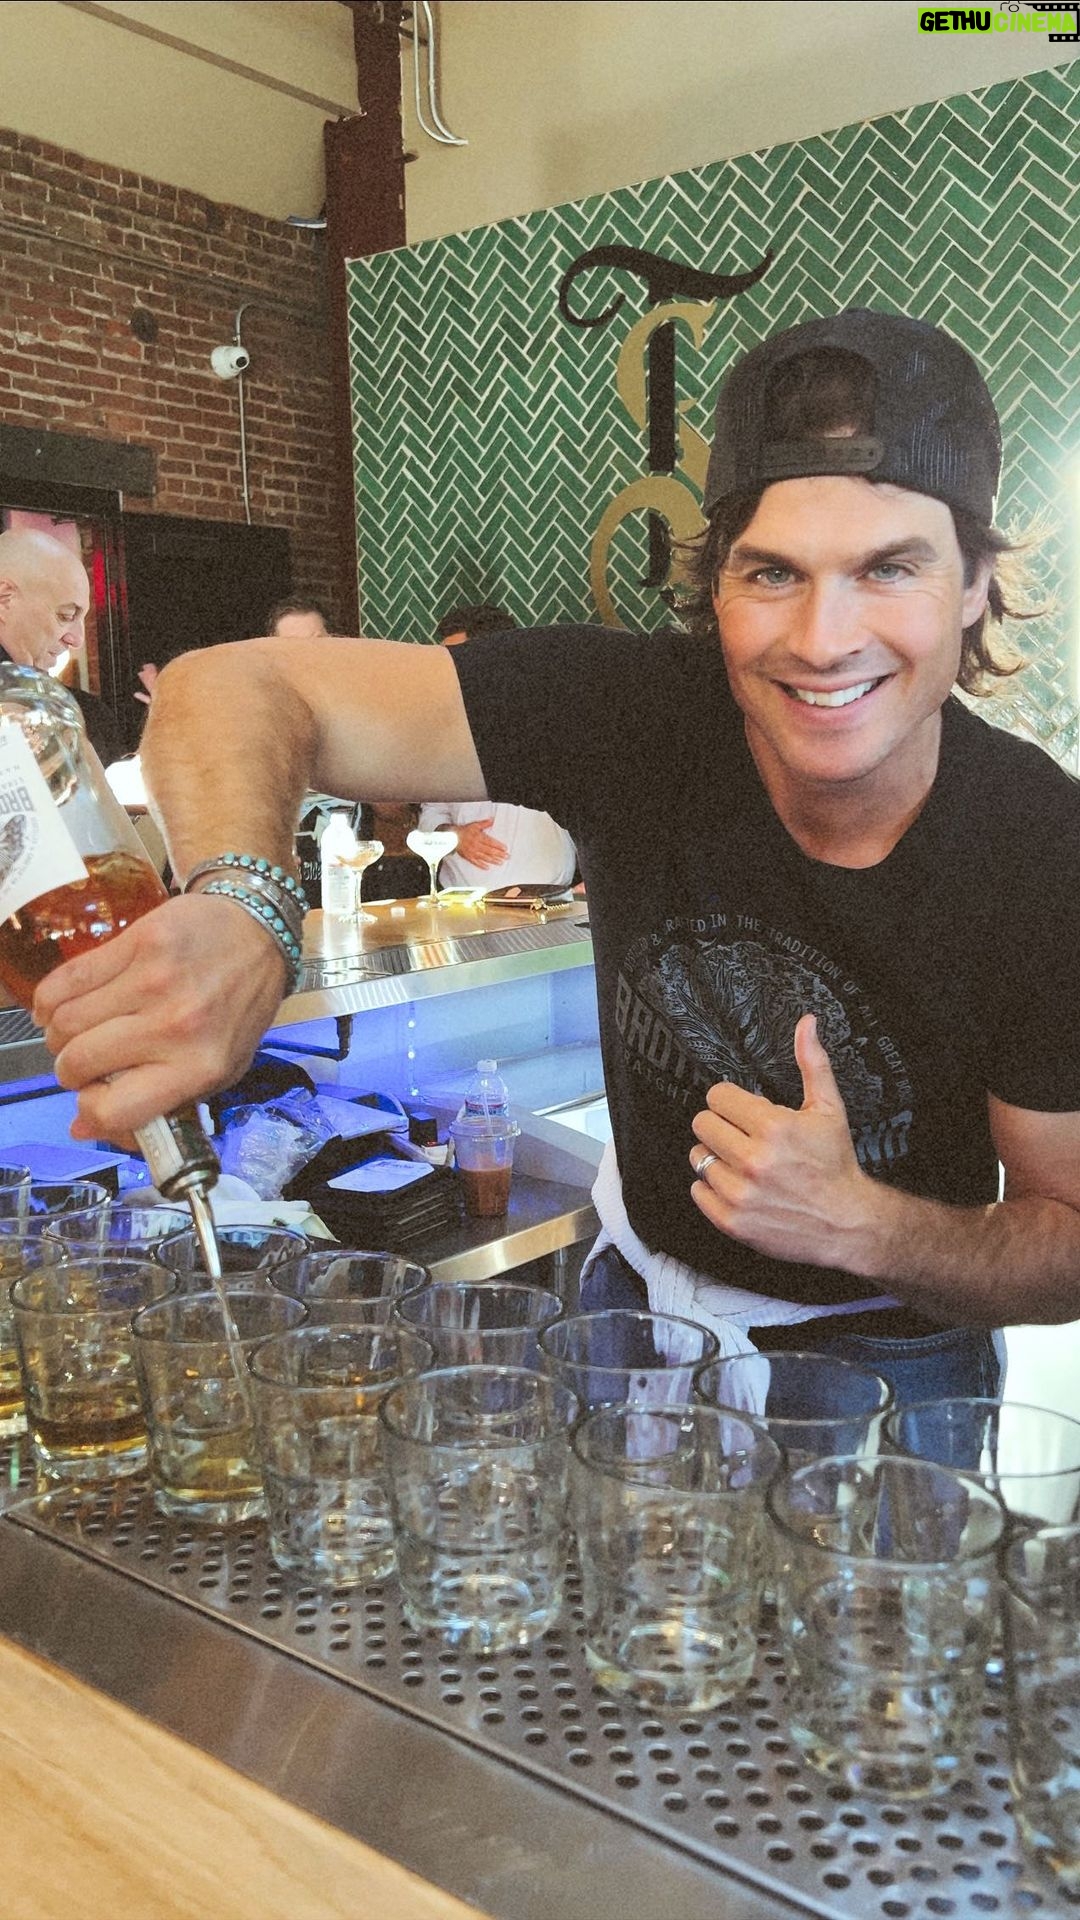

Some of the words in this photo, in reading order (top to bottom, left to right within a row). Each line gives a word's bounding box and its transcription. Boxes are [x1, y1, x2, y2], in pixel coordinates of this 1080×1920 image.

[709, 912, 727, 928] IN
[736, 913, 762, 932] THE
[768, 927, 842, 980] TRADITION
[843, 980, 862, 997] OF
[877, 1035, 907, 1075] GREAT
